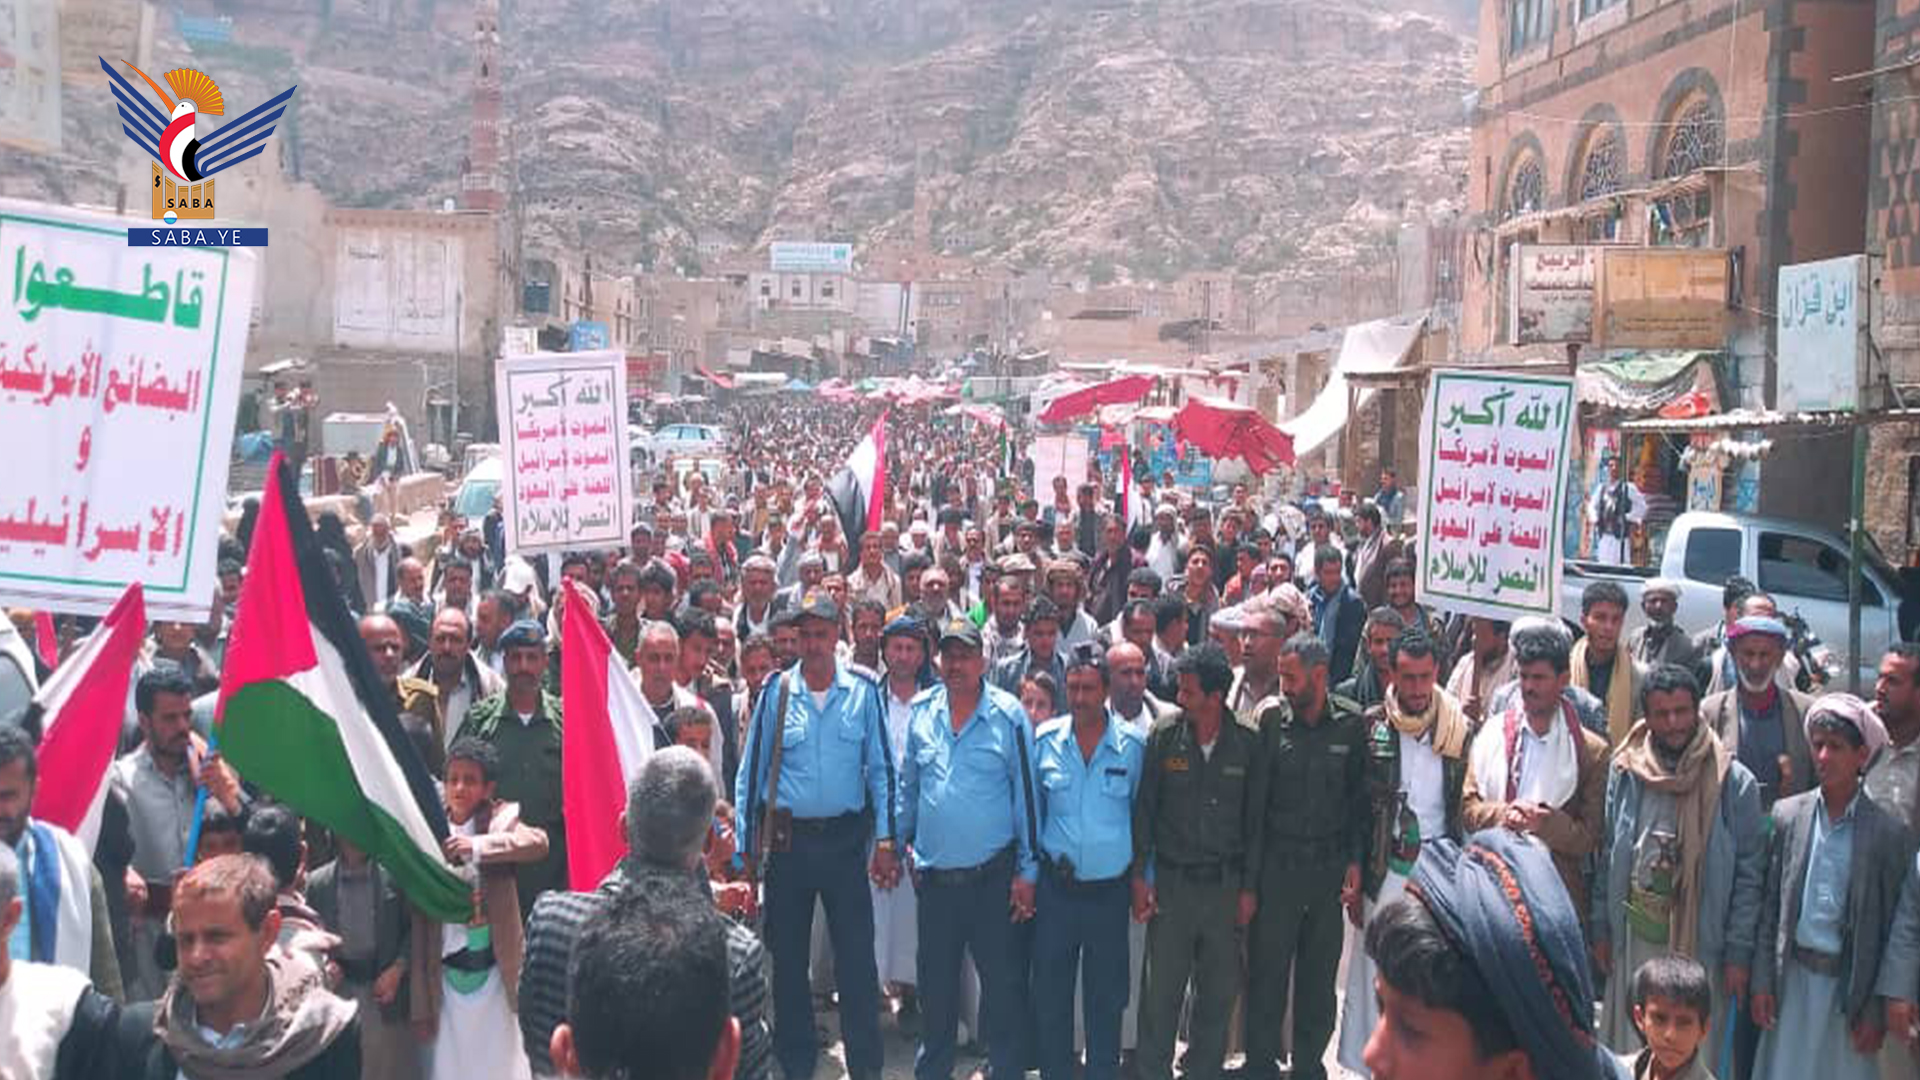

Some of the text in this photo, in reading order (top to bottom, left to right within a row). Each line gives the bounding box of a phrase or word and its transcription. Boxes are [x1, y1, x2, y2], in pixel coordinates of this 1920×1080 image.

[13, 245, 204, 328] قاطعوا
[103, 355, 201, 421] البضائع
[516, 375, 610, 417] الله أكبر
[571, 416, 611, 440] الموت
[1441, 385, 1562, 434] الله أكبر
[75, 425, 92, 472] و
[572, 446, 614, 469] الموت
[1504, 446, 1553, 473] الموت
[574, 501, 617, 535] النصر
[1499, 486, 1550, 513] الموت
[1432, 516, 1549, 550] اللعنة على اليهود
[1429, 548, 1544, 594] النصر للإسلام
